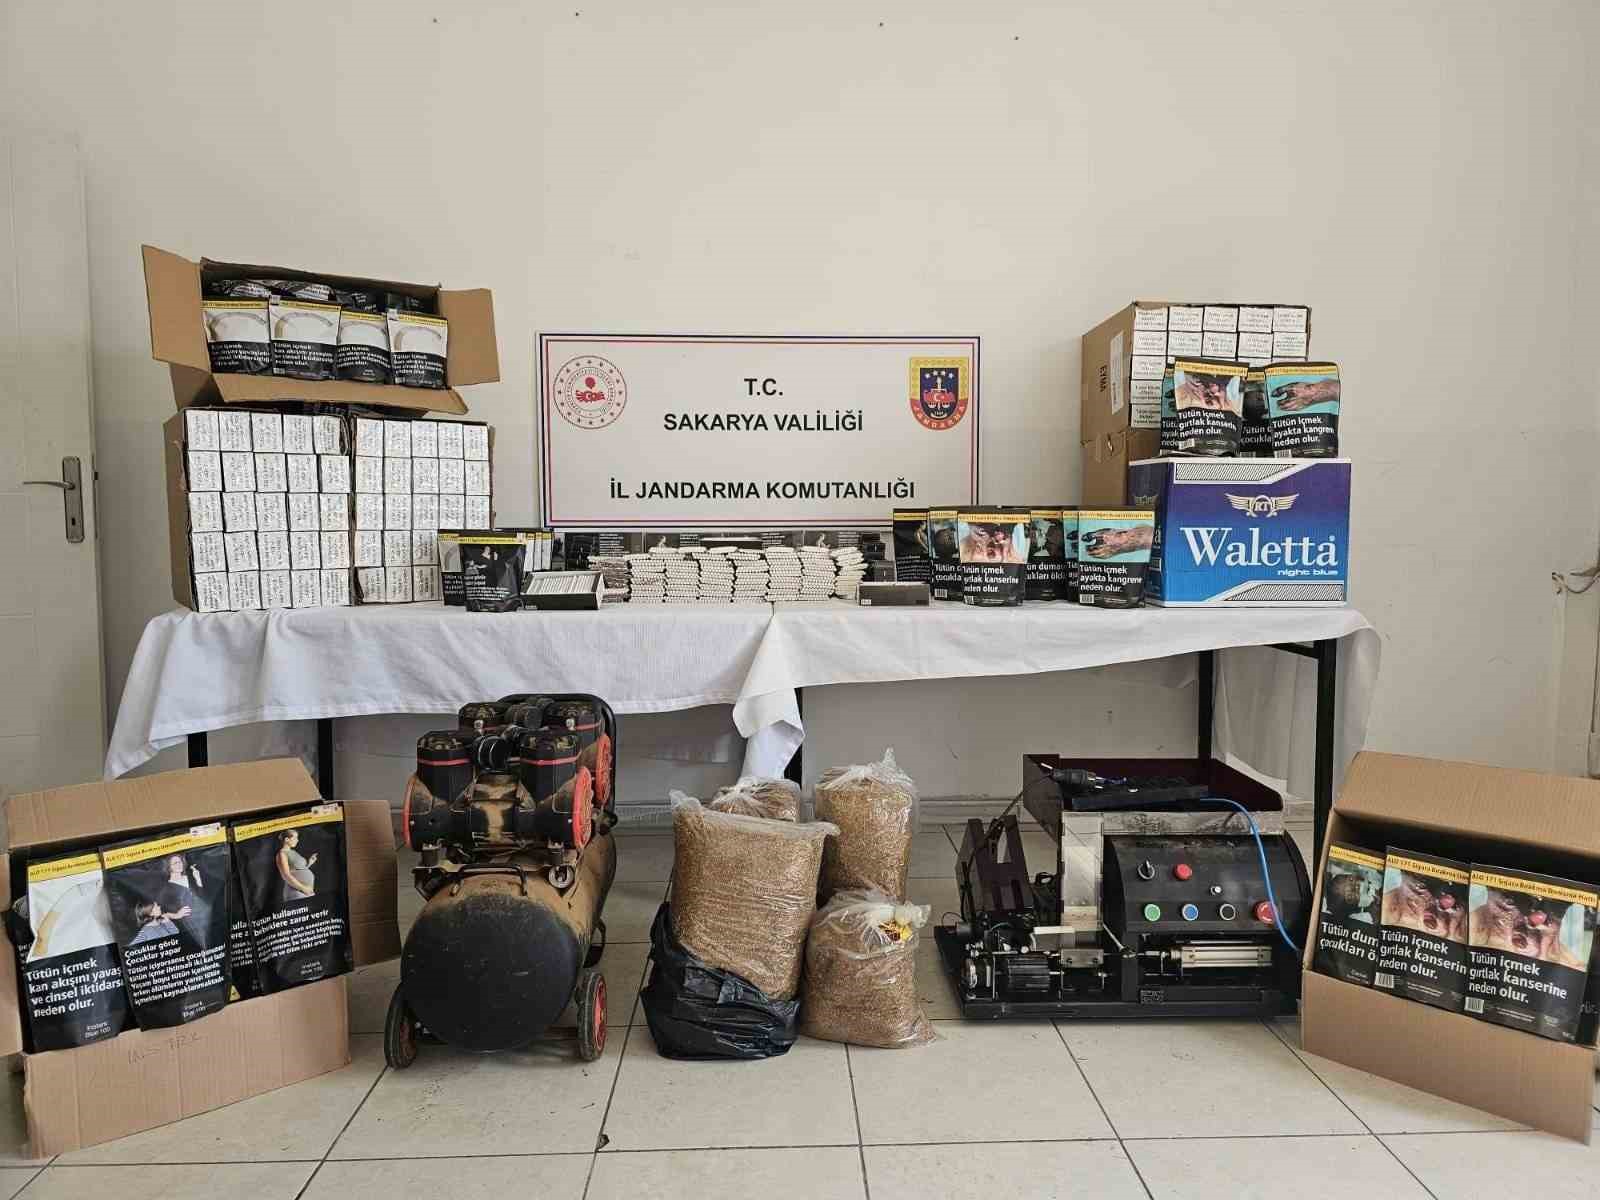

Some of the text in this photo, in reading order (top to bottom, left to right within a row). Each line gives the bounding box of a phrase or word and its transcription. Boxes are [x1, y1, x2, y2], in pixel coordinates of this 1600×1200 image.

[744, 378, 783, 396] T.C.
[664, 410, 863, 431] SAKARYA VALİLİĞİ
[1179, 409, 1200, 419] Tütün
[1272, 419, 1296, 428] Tütün
[1180, 427, 1204, 437] neden
[1274, 427, 1301, 438] ayakta
[1275, 437, 1300, 447] neden
[610, 477, 915, 499] İL JANDARMA KOMUTANLIĞI
[981, 566, 1004, 575] içmek
[1080, 564, 1127, 575] Tütün içmek
[1277, 568, 1339, 577] night blue
[1080, 574, 1106, 583] ayakta
[1080, 582, 1103, 591] neden
[983, 584, 1000, 592] olur.
[290, 914, 309, 925] zarar
[311, 909, 328, 919] verir
[1321, 922, 1349, 938] Tütün
[125, 939, 178, 958] Çocuklar görür
[1320, 937, 1365, 958] çocukları
[1380, 943, 1411, 958] gırtlak
[1382, 930, 1448, 955] Tütün içmek
[126, 947, 181, 966] Çocuklar yapar
[1470, 951, 1540, 976] Tütün içmek
[26, 957, 97, 981] Tütün içmek
[127, 966, 148, 975] Tütün
[166, 962, 193, 973] ihtimali
[1380, 958, 1438, 980] neden olur.
[29, 982, 48, 994] kan
[51, 974, 89, 989] akışını
[153, 975, 170, 986] boyu
[171, 970, 190, 979] tütün
[1470, 967, 1567, 999] gırtlak kanserine
[151, 981, 183, 993] ölümlerin
[1469, 982, 1529, 1003] neden olur.
[31, 996, 44, 1005] ve
[45, 987, 77, 1003] cinsel
[33, 999, 95, 1018] neden olur.
